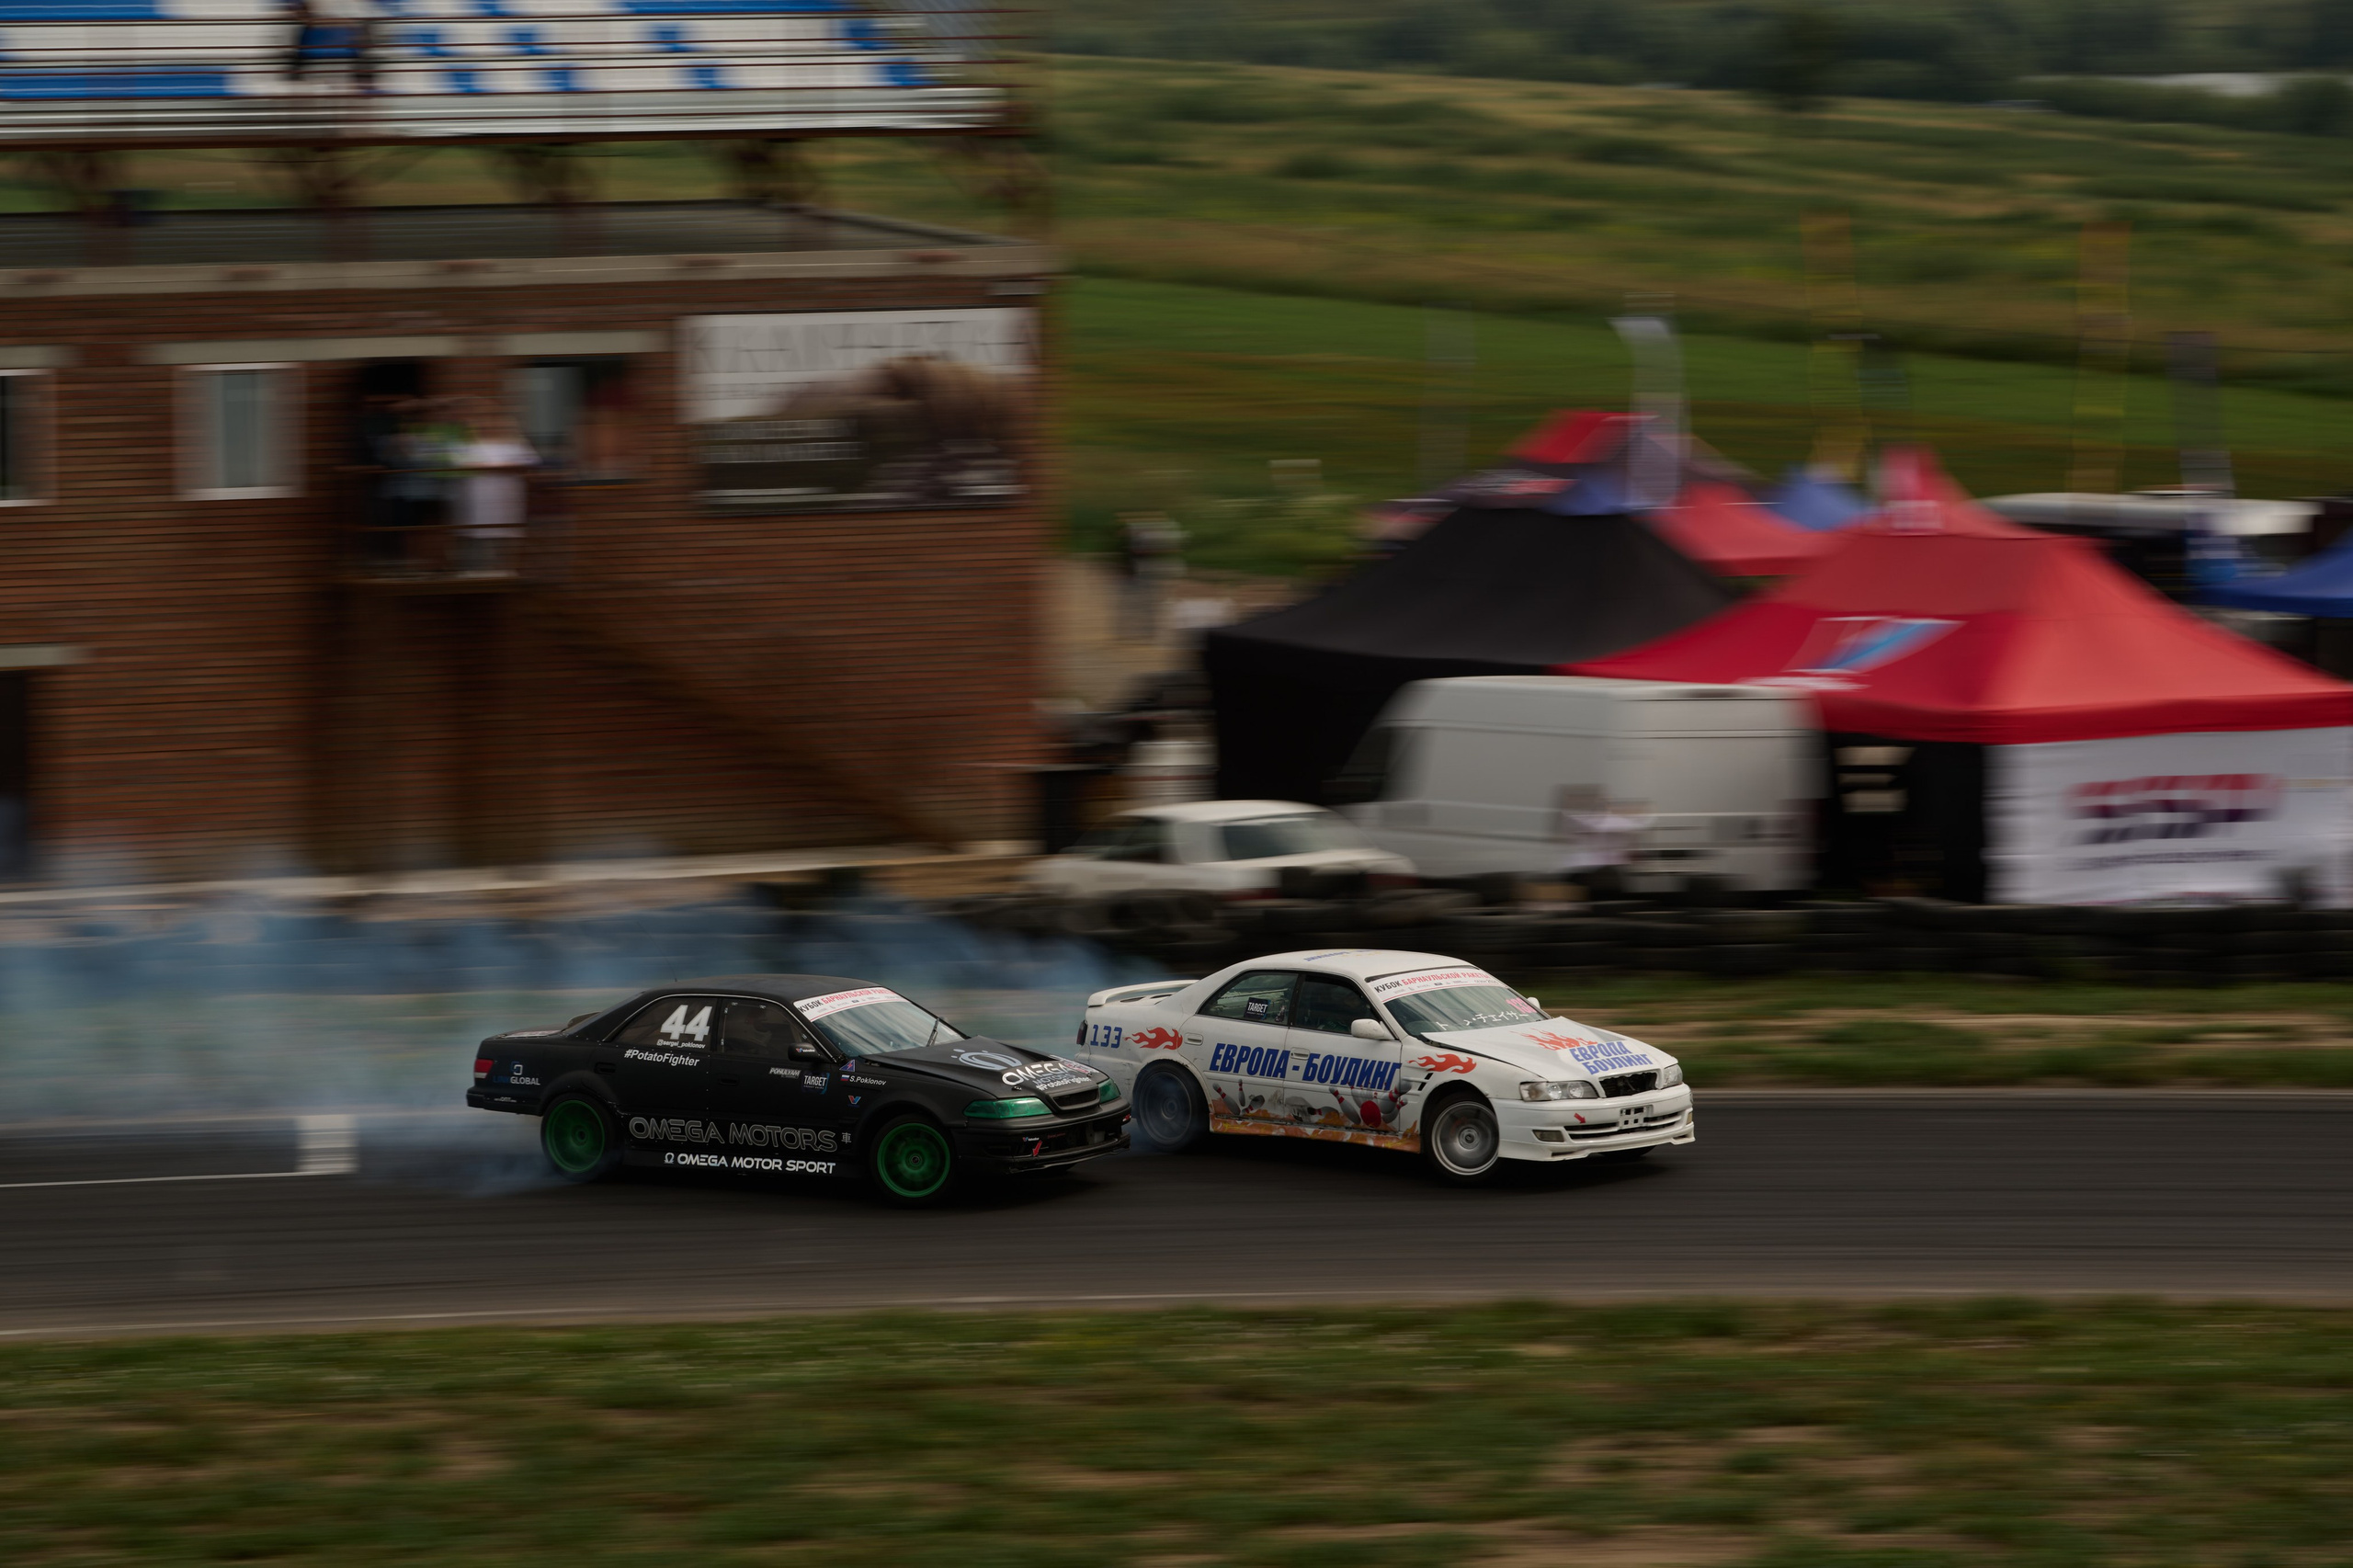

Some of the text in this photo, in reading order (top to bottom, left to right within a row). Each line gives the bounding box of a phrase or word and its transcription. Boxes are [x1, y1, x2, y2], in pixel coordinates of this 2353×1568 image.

[1374, 981, 1403, 994] КУБОК
[1402, 971, 1461, 986] БАРНАУЛЬСКОЙ
[798, 1000, 824, 1013] КУБОК
[1247, 1002, 1268, 1013] TARGET
[660, 1005, 712, 1041] 44
[1090, 1024, 1122, 1049] 133
[624, 1049, 699, 1066] #PotatoFighter
[1569, 1041, 1631, 1062] ЕВРОПА
[1002, 1062, 1075, 1085] OMEGA
[1209, 1042, 1290, 1078] ЕВРОПА
[1302, 1052, 1402, 1091] БОУЛИНГ
[1582, 1053, 1654, 1075] БОУЛИНГ
[804, 1075, 827, 1086] TARGET
[849, 1075, 886, 1086] S.Poklonov
[629, 1117, 837, 1153] OMEGA MOTORS
[676, 1153, 728, 1168] OMEGA
[731, 1156, 782, 1171] MOTOR
[785, 1159, 836, 1175] SPORT
